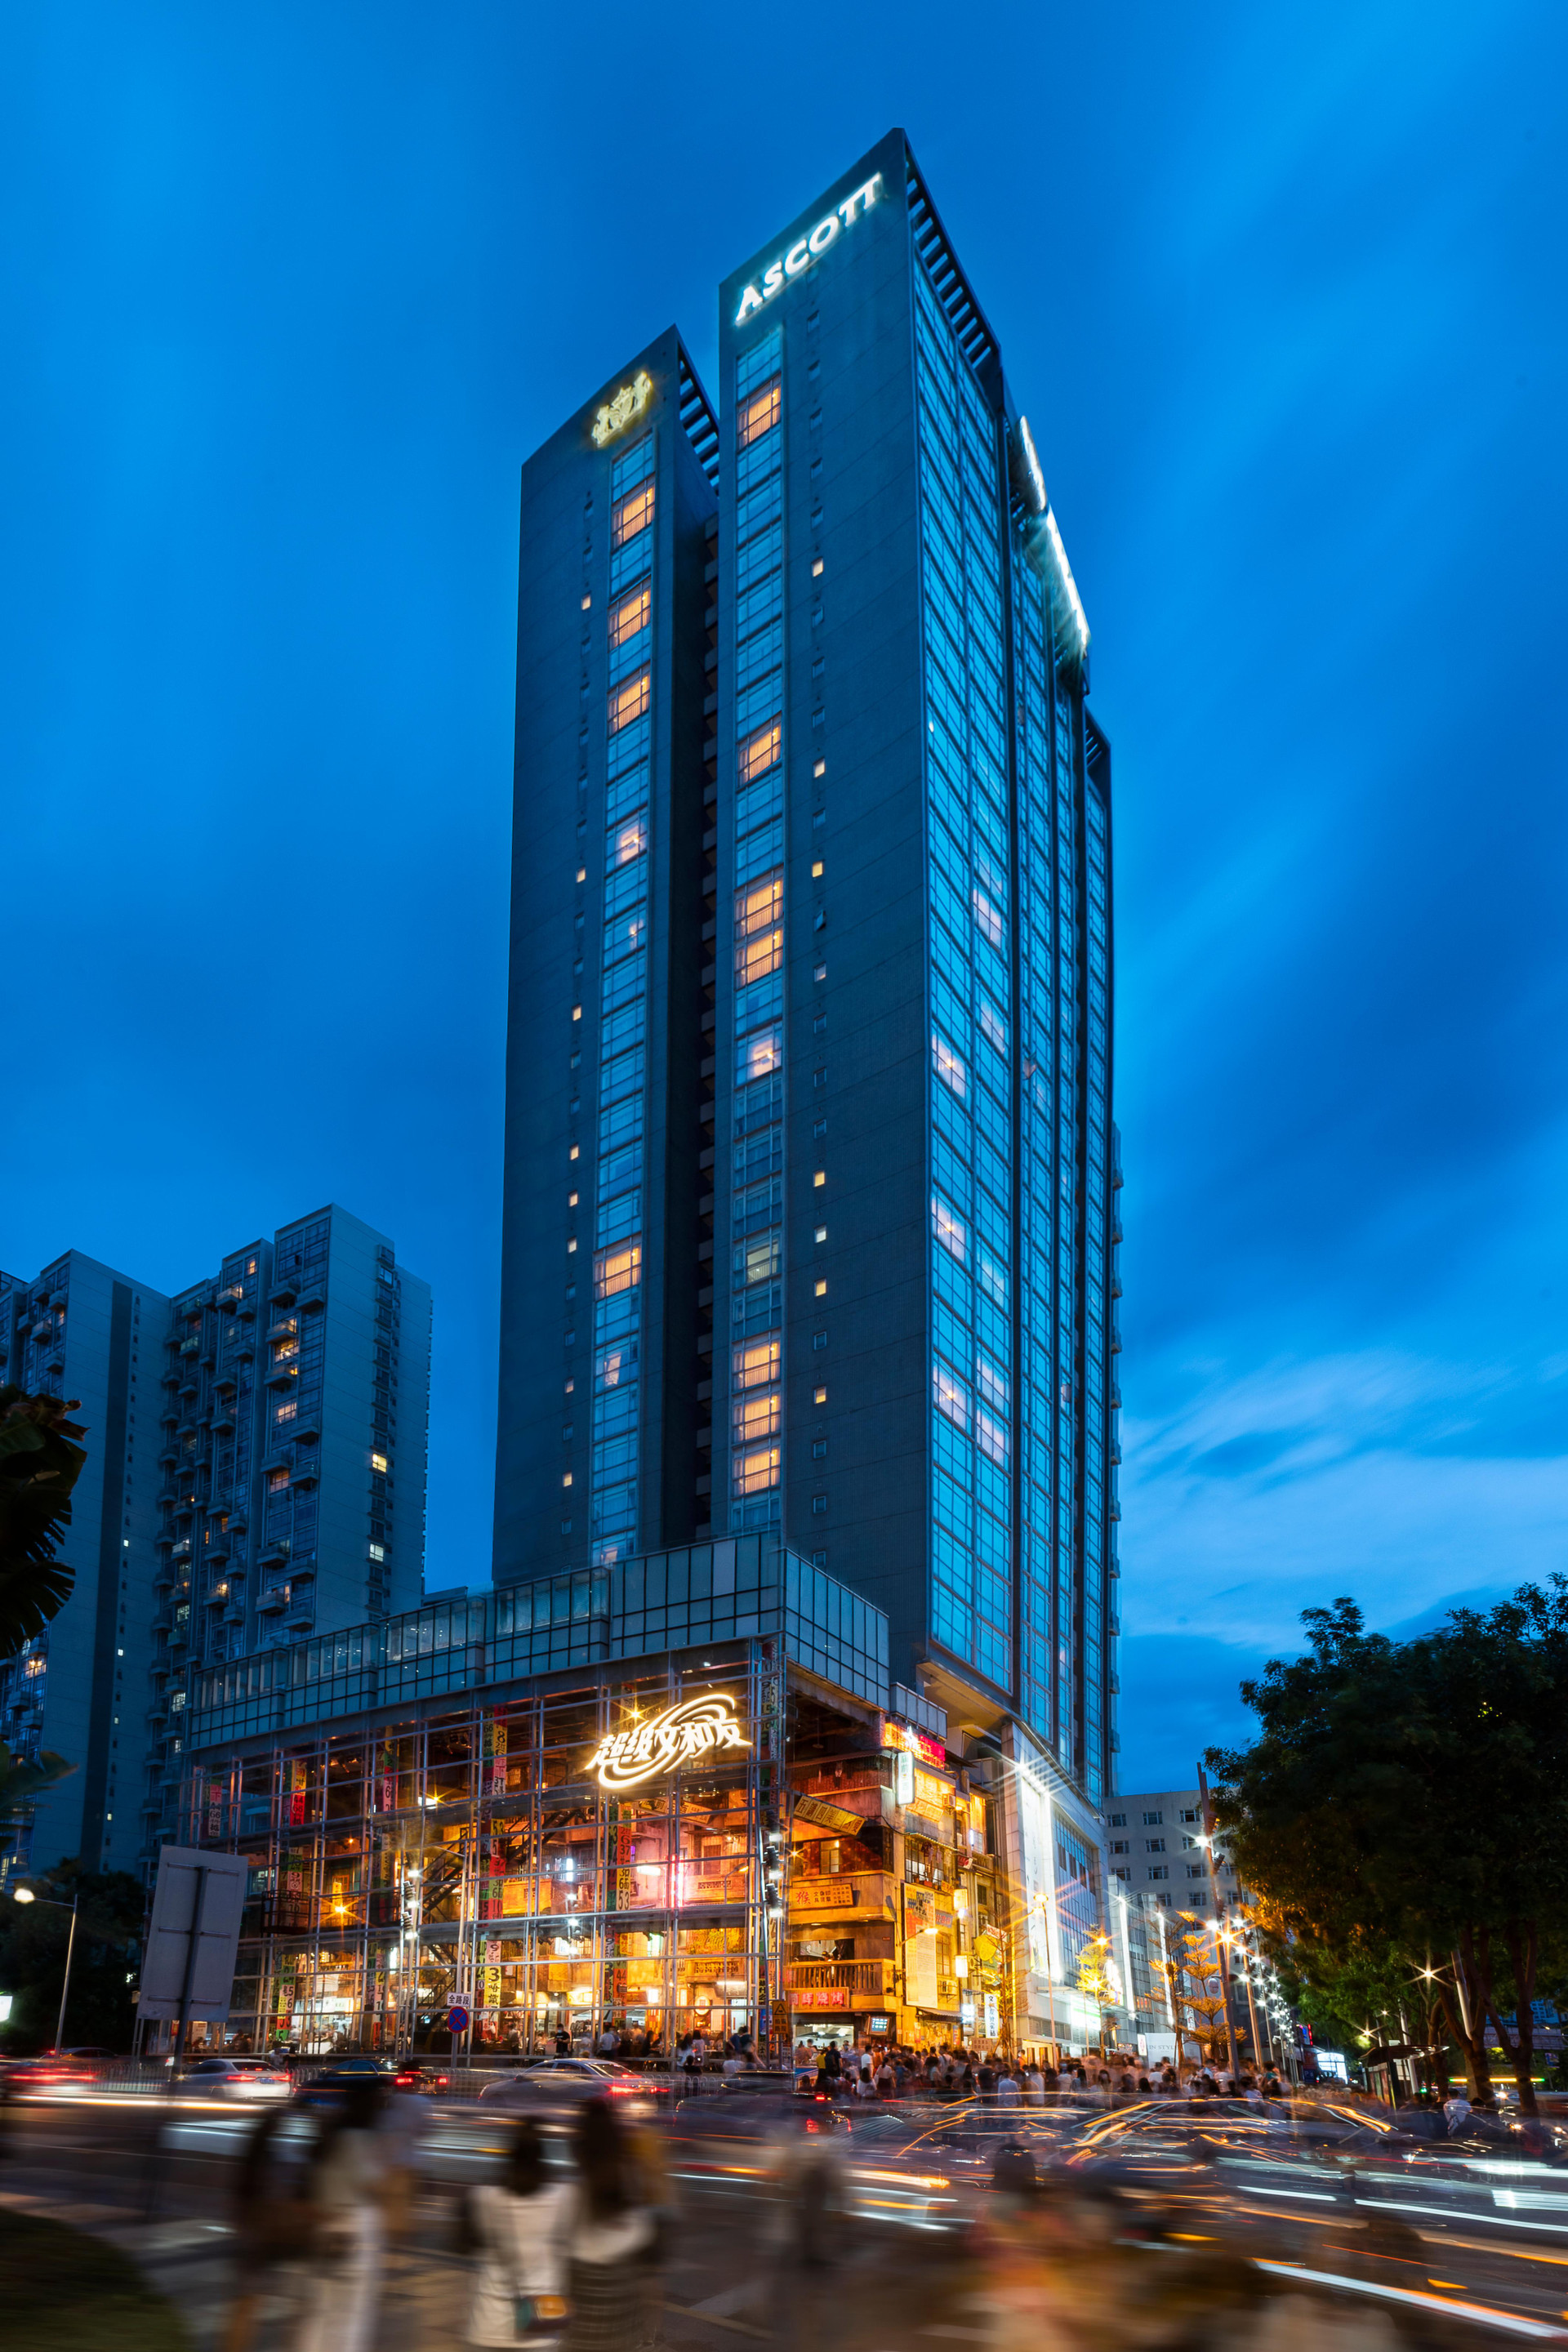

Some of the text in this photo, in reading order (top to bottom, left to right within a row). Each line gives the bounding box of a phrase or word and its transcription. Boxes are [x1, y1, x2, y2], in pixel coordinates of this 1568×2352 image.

[735, 172, 882, 325] ASCOTT
[583, 1717, 753, 1771] 超级文和友
[448, 1994, 470, 2005] 全路段
